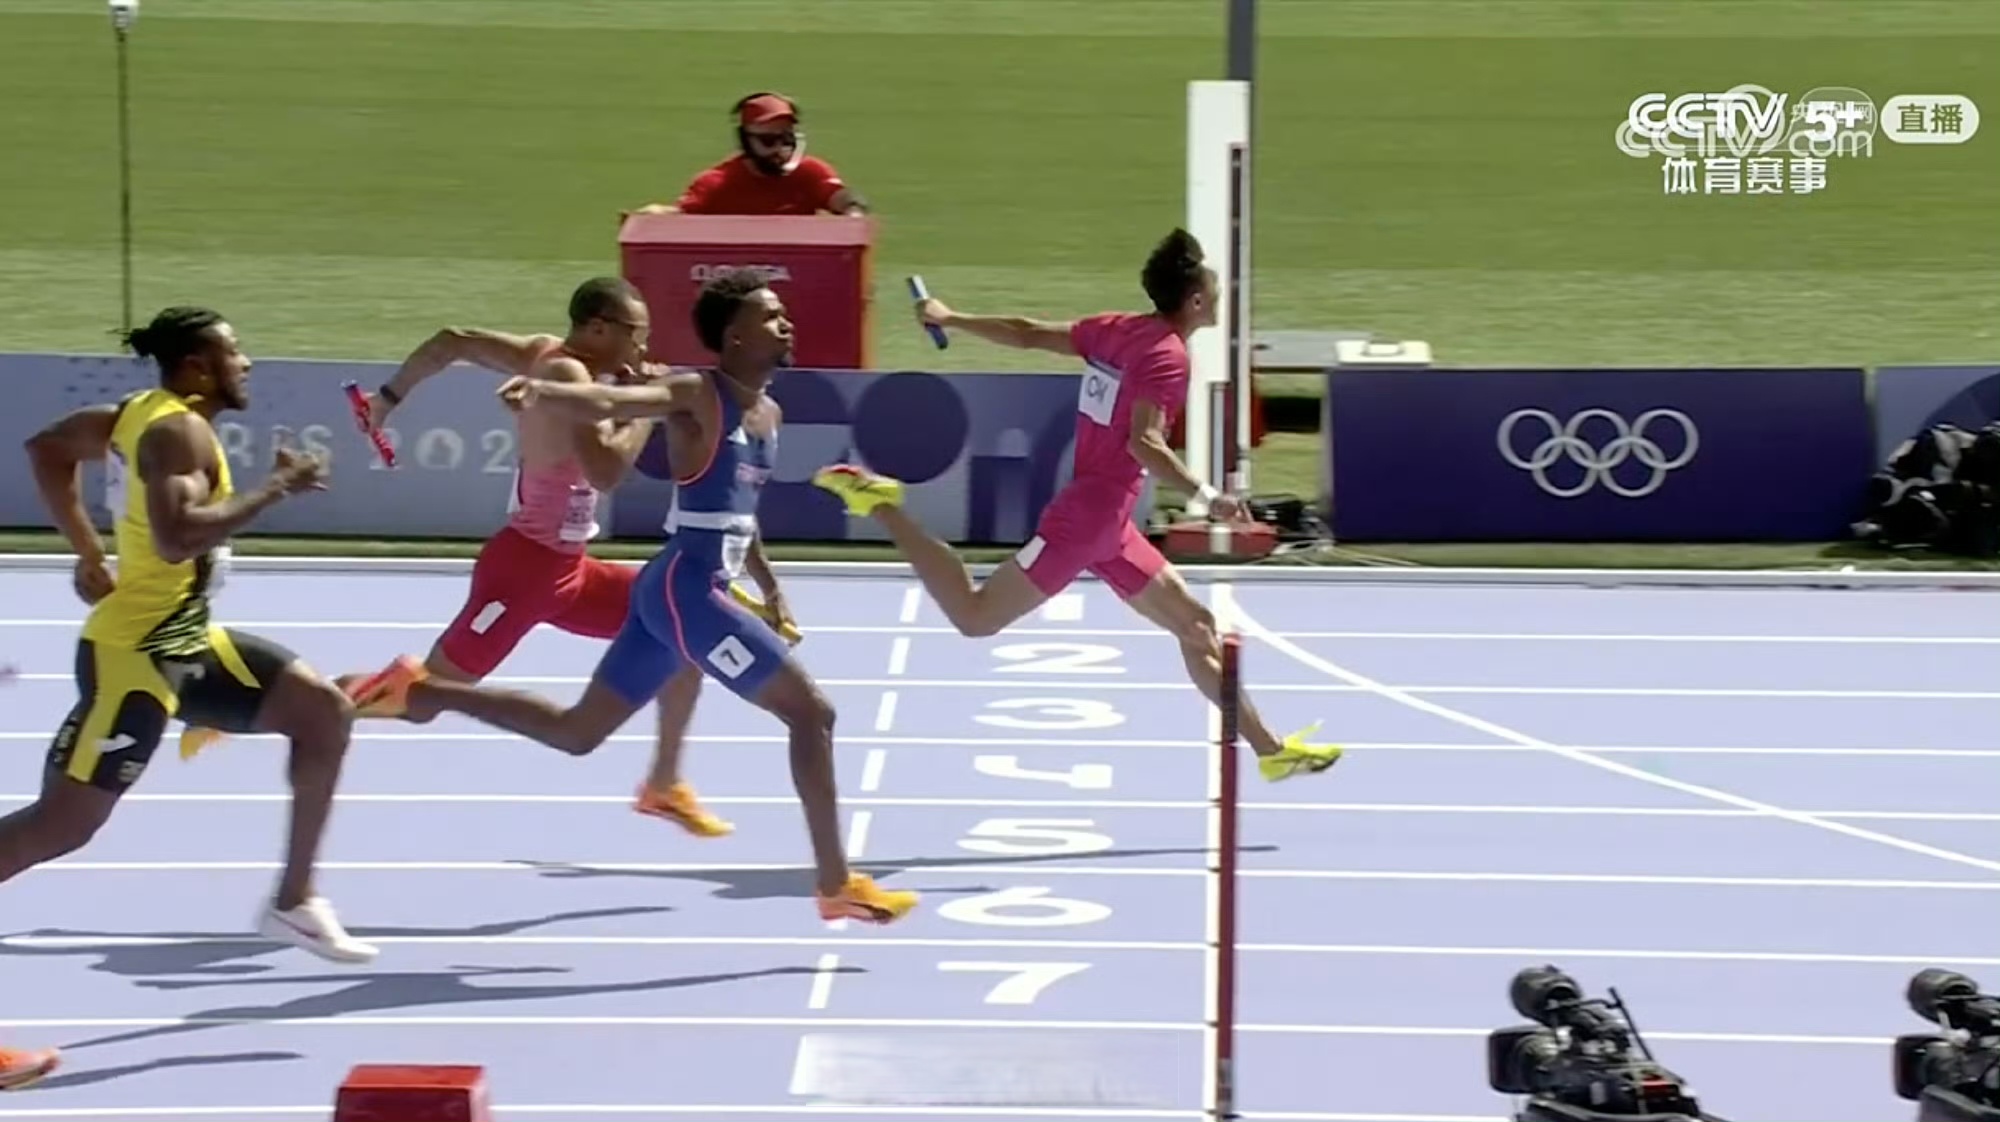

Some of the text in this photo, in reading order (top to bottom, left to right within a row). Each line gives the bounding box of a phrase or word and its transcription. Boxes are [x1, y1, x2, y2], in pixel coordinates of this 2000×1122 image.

[720, 649, 739, 667] 7
[990, 642, 1127, 674] 2
[973, 697, 1126, 730] 3
[956, 818, 1114, 854] 5
[937, 886, 1113, 926] 6
[937, 961, 1093, 1004] 7
